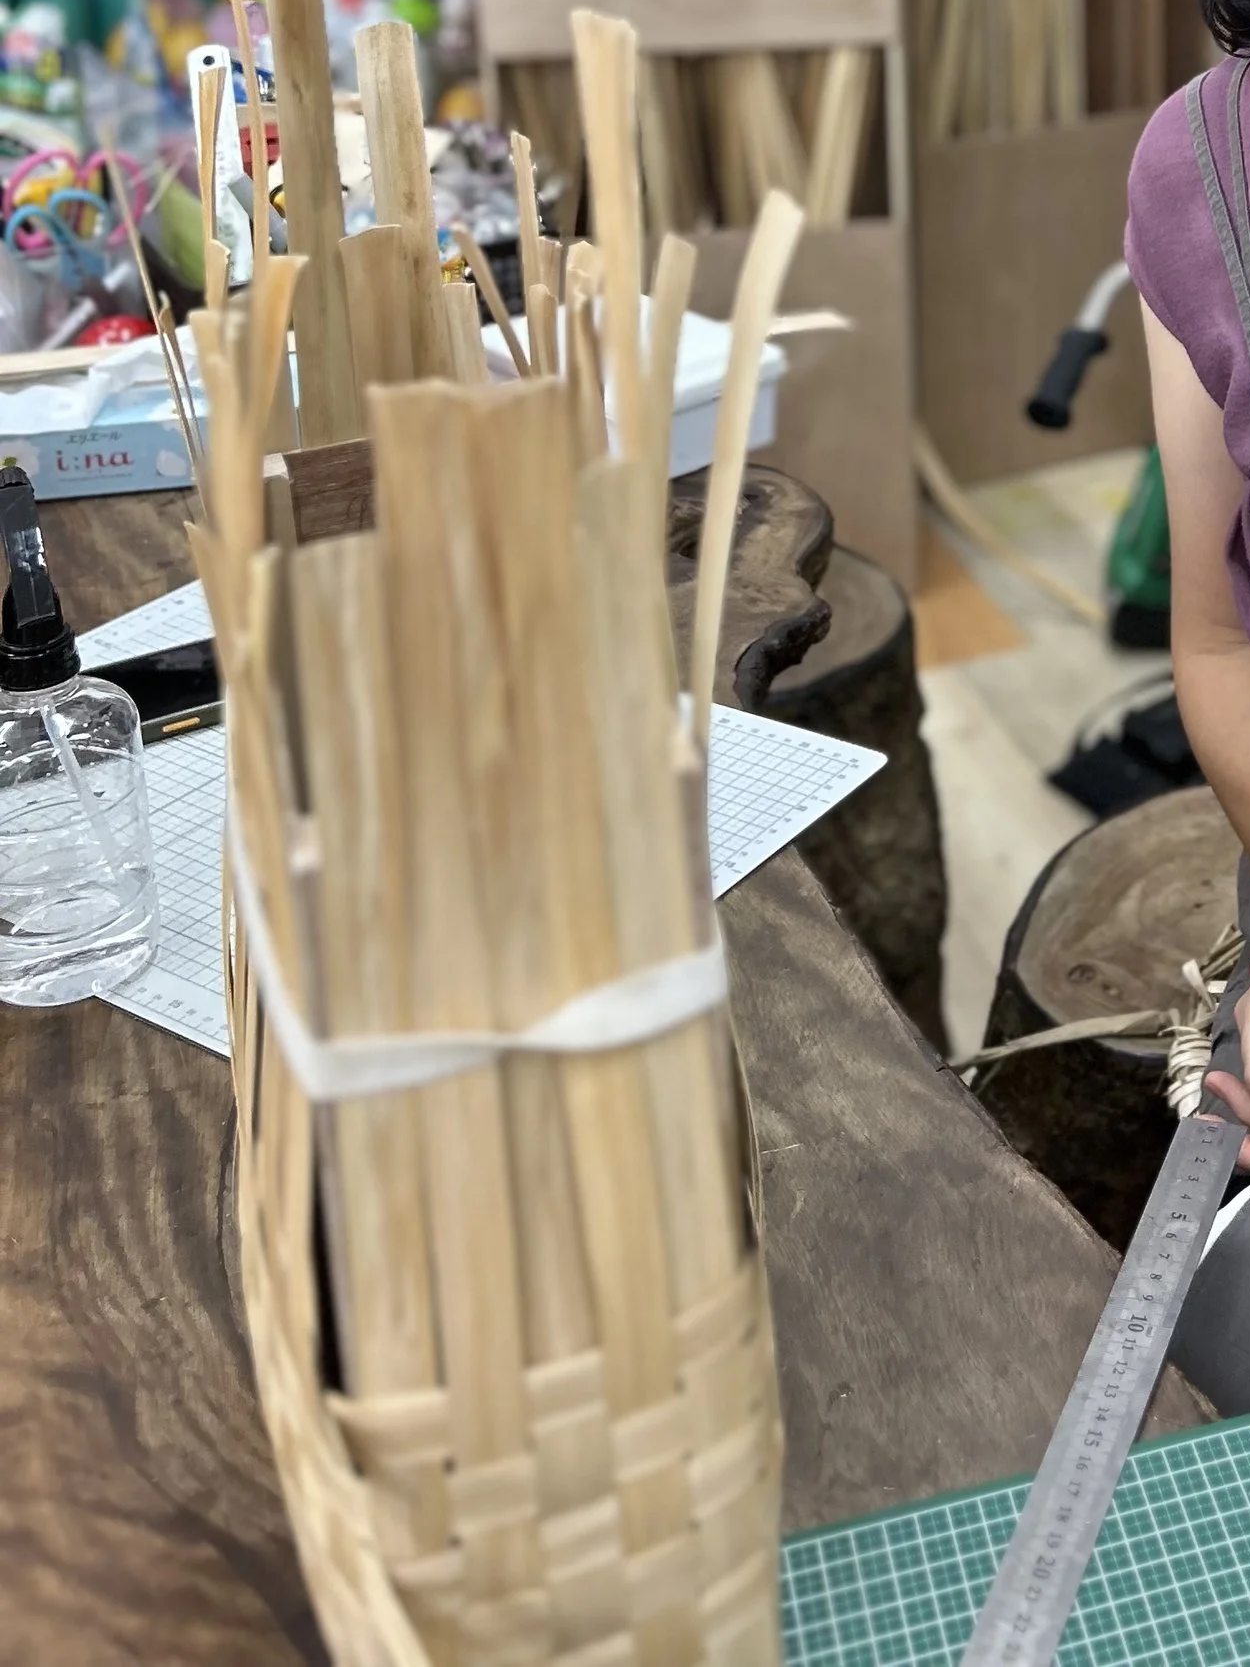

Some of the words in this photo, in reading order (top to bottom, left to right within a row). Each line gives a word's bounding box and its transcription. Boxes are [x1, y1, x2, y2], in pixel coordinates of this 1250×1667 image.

[1194, 1156, 1207, 1164] 2
[1180, 1193, 1192, 1201] 4
[1171, 1211, 1187, 1221] 5
[1158, 1252, 1170, 1260] 7
[1150, 1272, 1162, 1281] 8
[1127, 1314, 1148, 1333] 10
[1121, 1336, 1136, 1351] 11
[1112, 1360, 1128, 1375] 12
[1104, 1383, 1120, 1399] 13
[1094, 1406, 1110, 1422] 14
[1083, 1428, 1103, 1448] 15
[1075, 1454, 1091, 1471] 16
[1067, 1480, 1082, 1498] 17
[1056, 1505, 1072, 1523] 18
[1046, 1532, 1062, 1549] 19
[1032, 1555, 1056, 1580] 20
